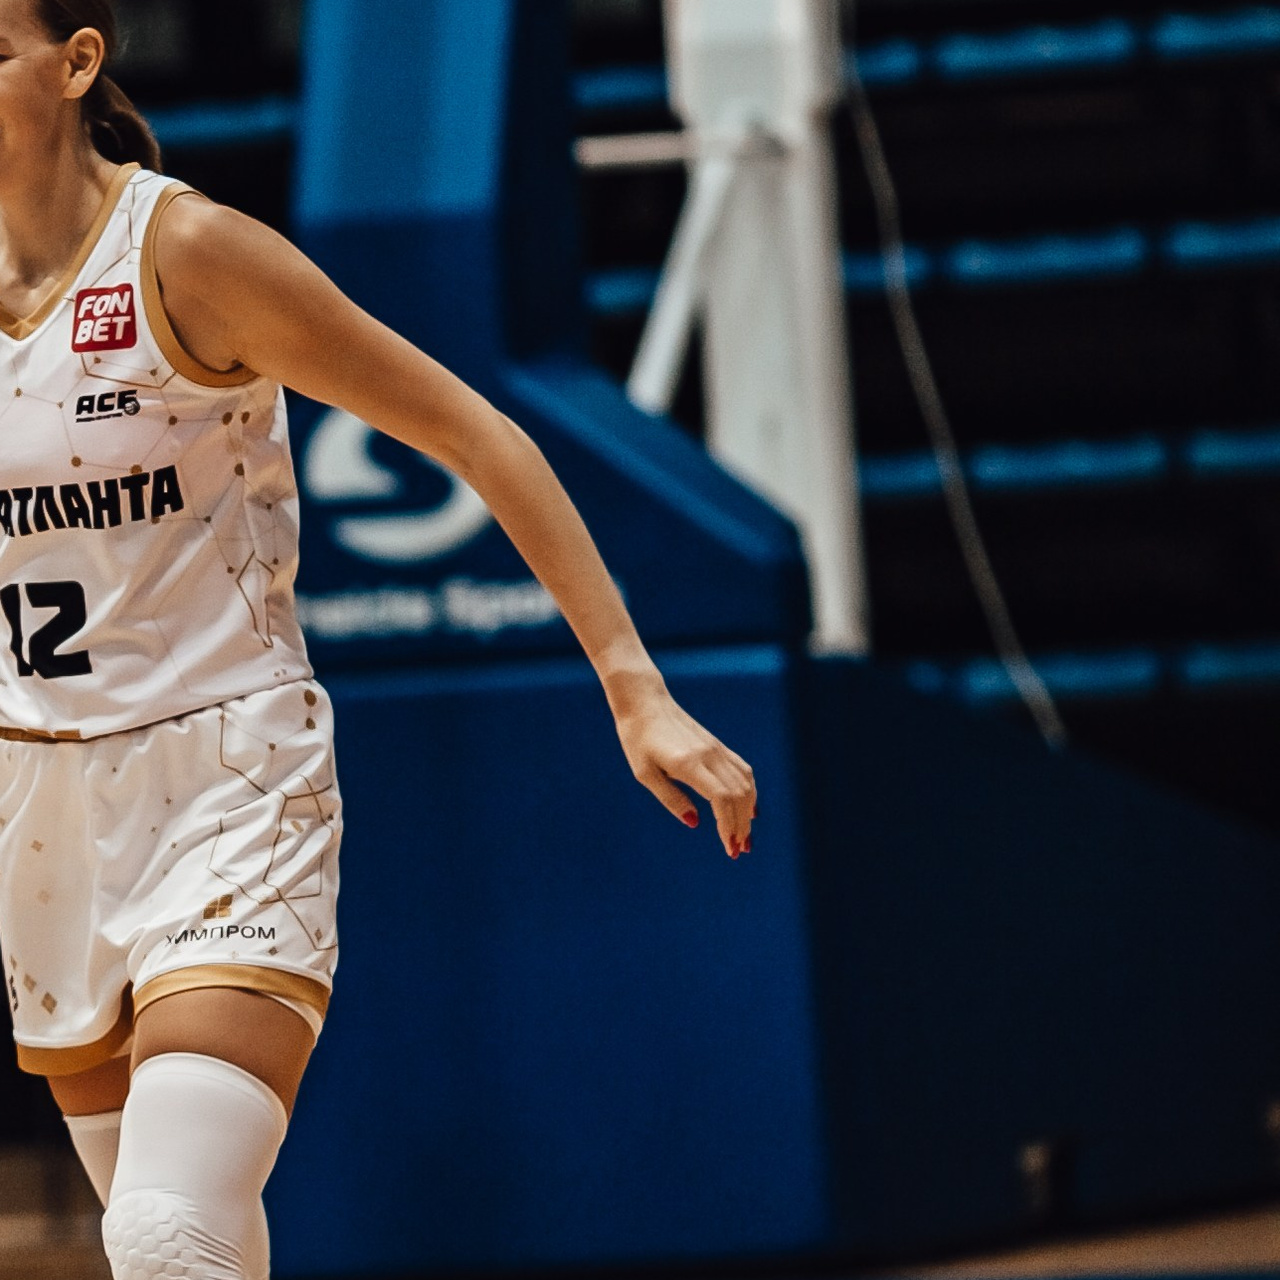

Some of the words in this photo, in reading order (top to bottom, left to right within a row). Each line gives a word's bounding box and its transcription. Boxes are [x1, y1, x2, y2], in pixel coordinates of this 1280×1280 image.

[78, 291, 131, 318] FON
[75, 316, 131, 344] BET
[0, 580, 93, 680] 12
[165, 925, 276, 946] ХИМПРОМ
